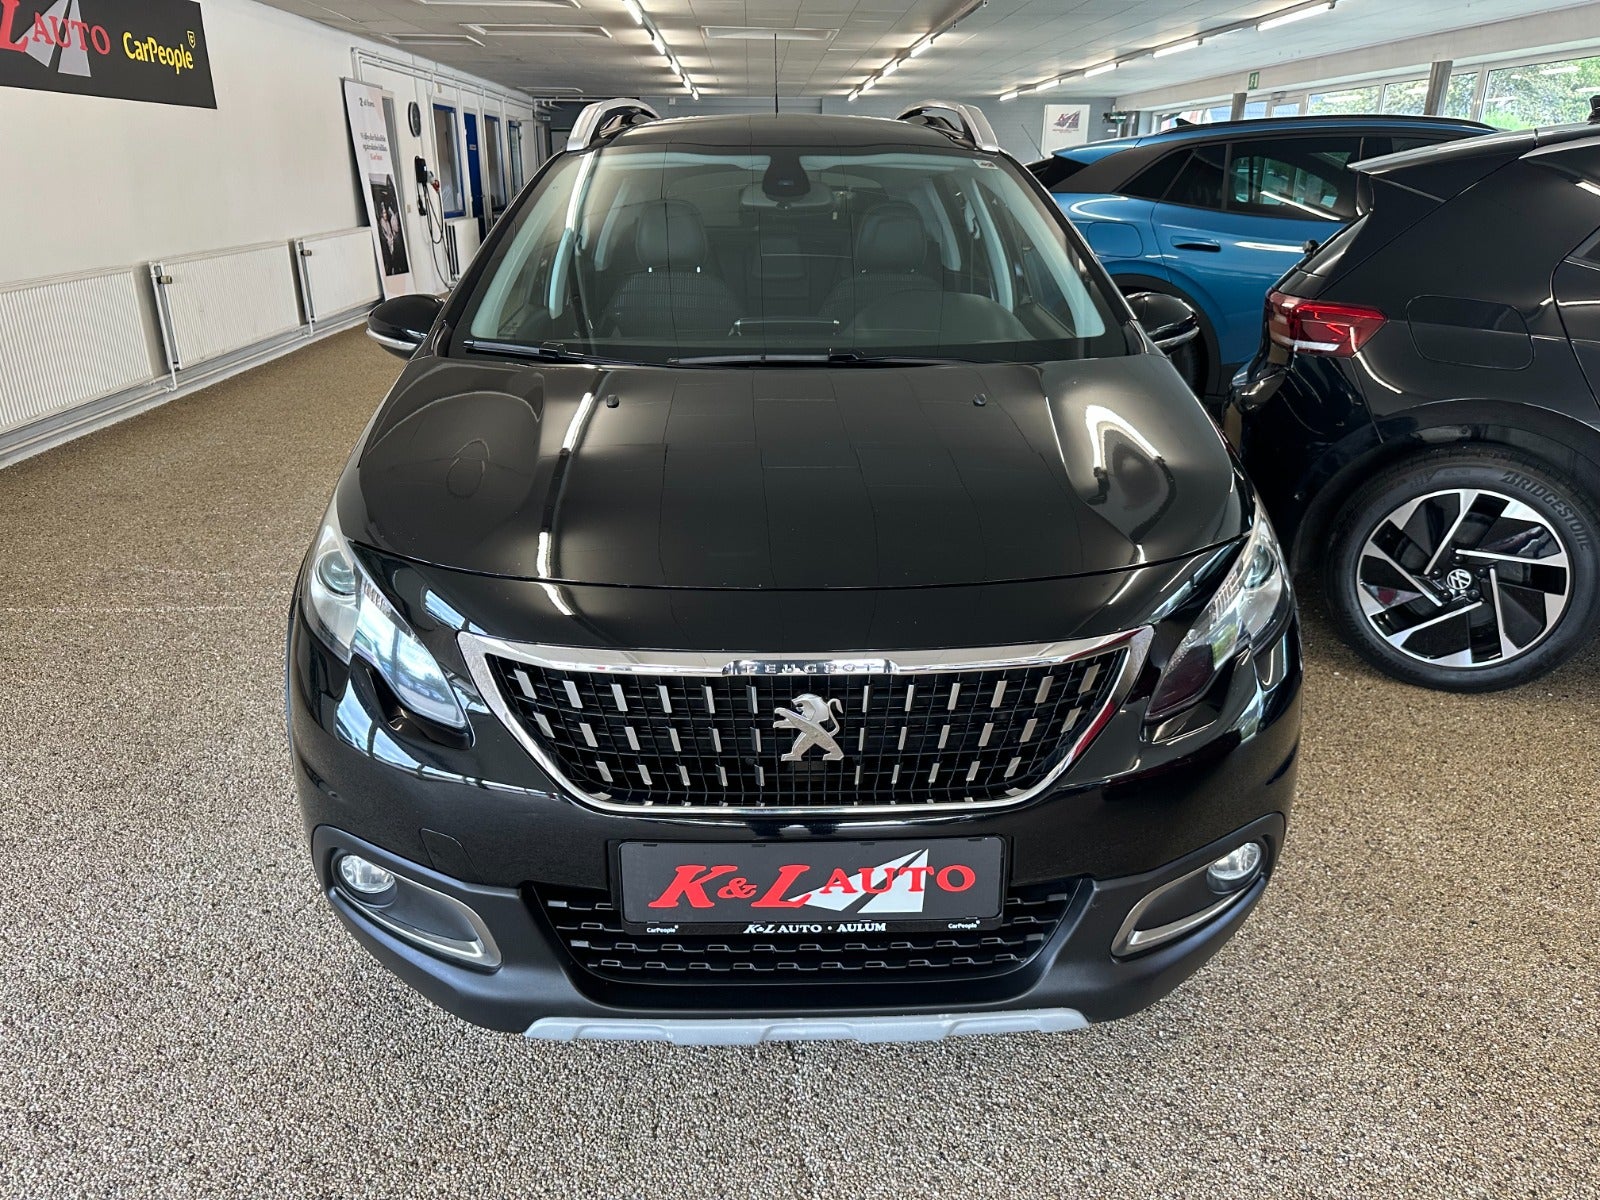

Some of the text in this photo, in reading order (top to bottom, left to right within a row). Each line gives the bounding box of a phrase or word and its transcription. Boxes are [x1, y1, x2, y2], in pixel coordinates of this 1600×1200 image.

[32, 12, 111, 55] AUTO
[122, 31, 194, 75] CarPeople
[648, 864, 977, 908] K&L AUTO
[646, 926, 676, 934] CarPeople
[778, 924, 823, 934] AUTO
[836, 922, 886, 932] AULUM
